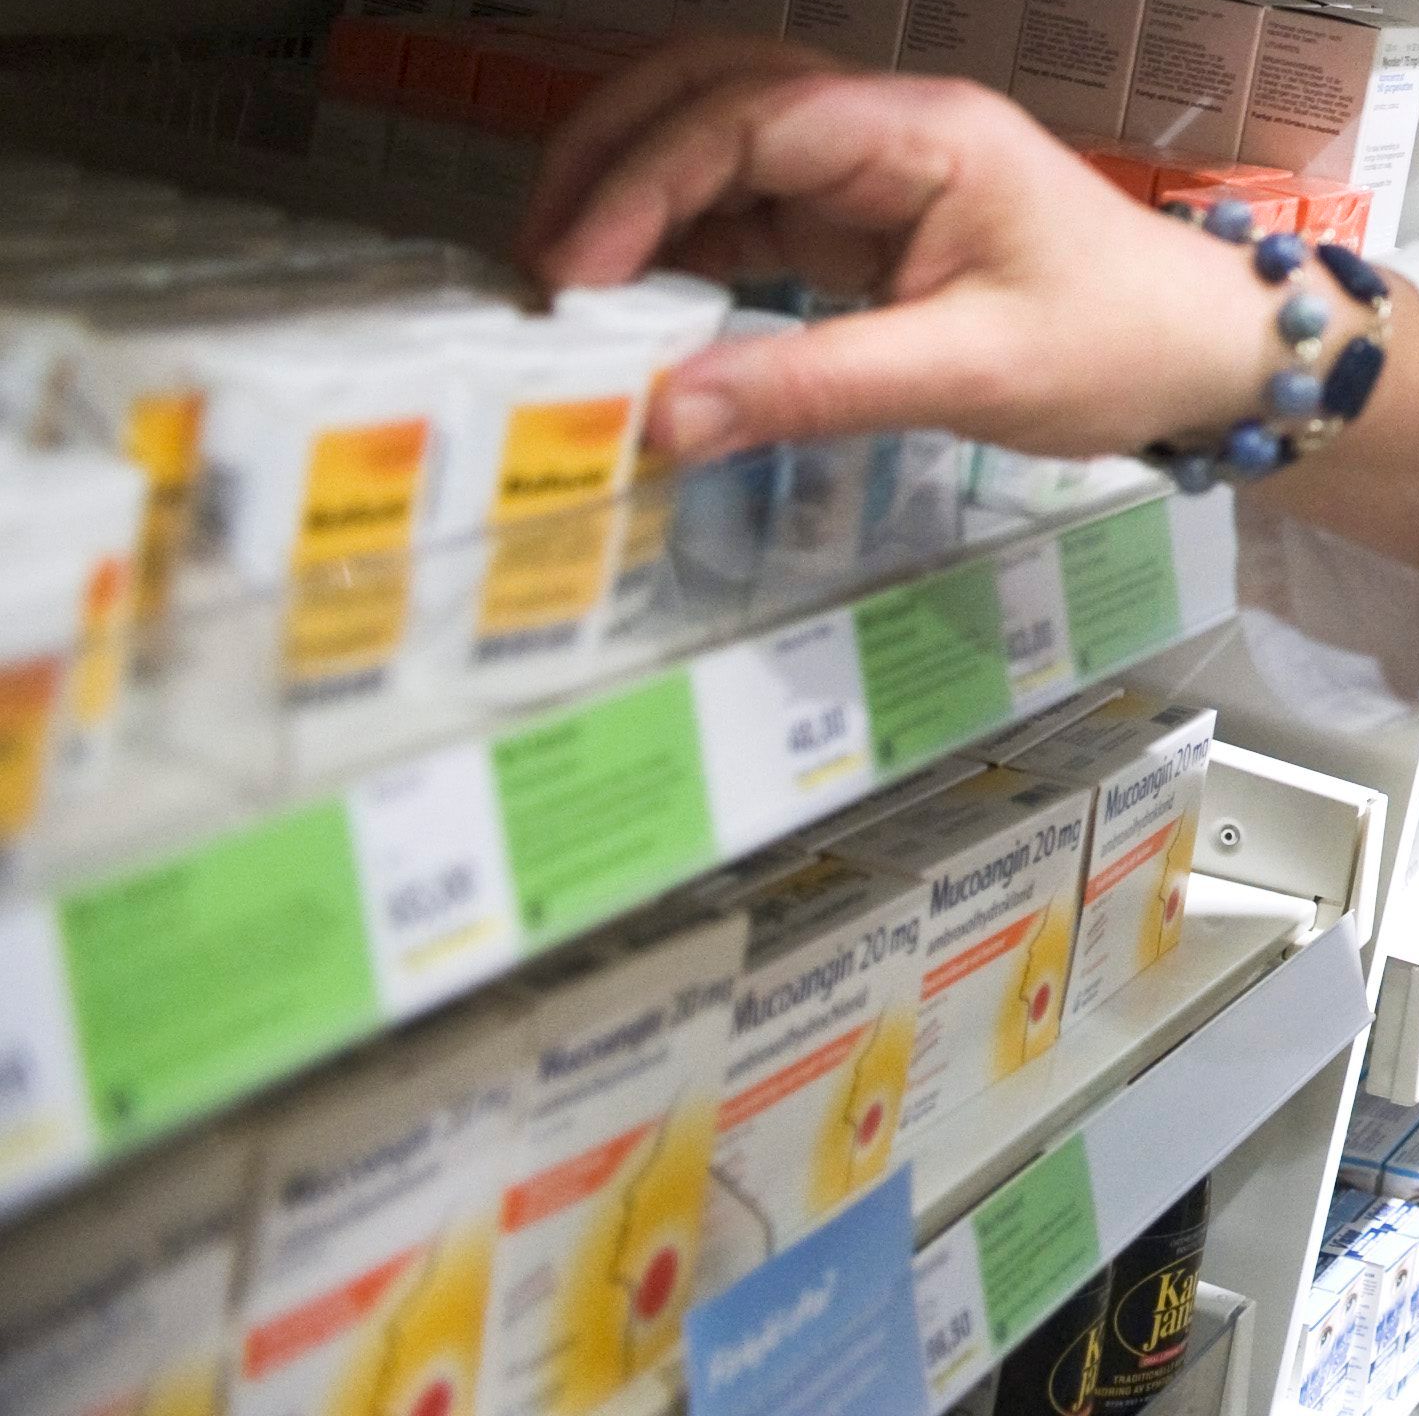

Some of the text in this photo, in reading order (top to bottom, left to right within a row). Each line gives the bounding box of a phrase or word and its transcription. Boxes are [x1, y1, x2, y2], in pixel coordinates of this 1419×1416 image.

[1104, 737, 1211, 823] Mucoangin 20 mg
[930, 818, 1082, 920] Mucoangin 20 mg
[732, 917, 921, 1040] Mucoangin 20 mg
[1142, 1306, 1194, 1352] jan
[1156, 1268, 1200, 1313] Ka
